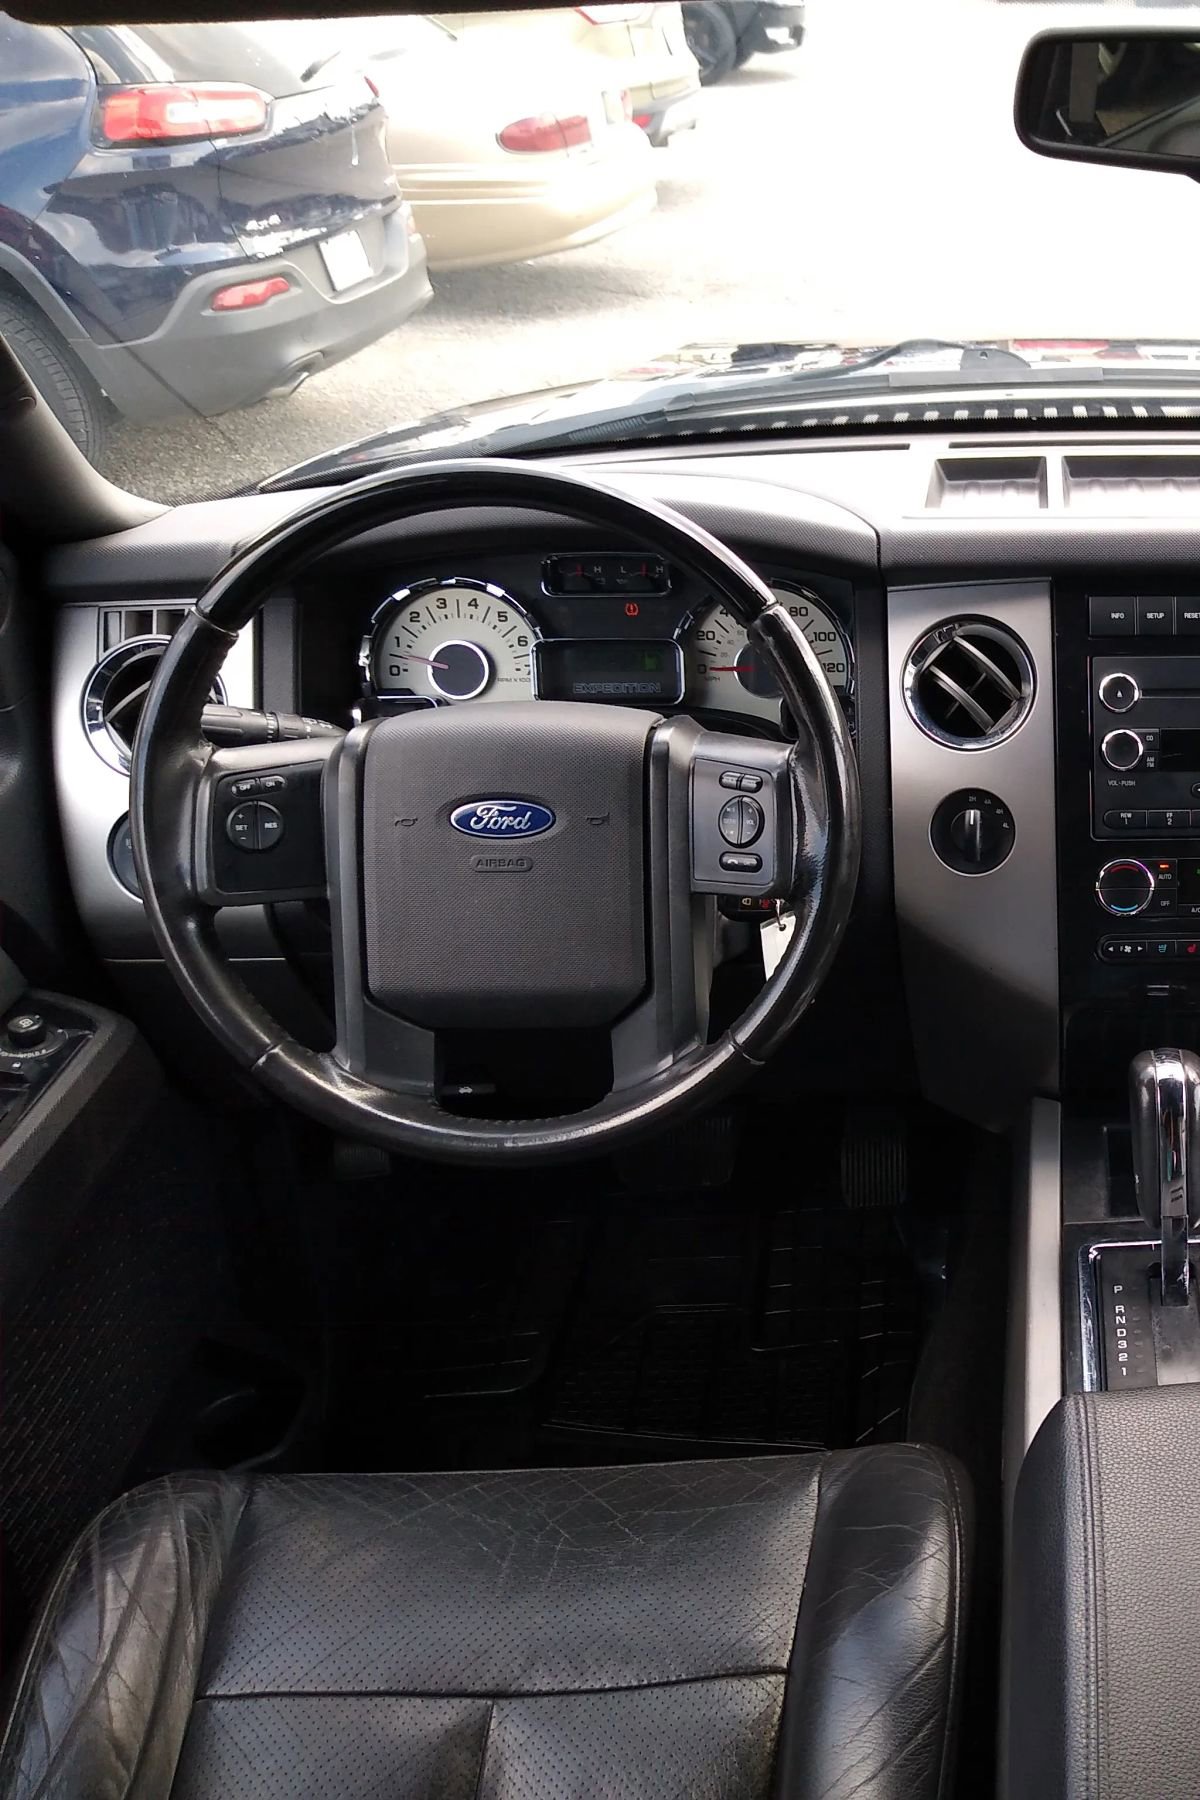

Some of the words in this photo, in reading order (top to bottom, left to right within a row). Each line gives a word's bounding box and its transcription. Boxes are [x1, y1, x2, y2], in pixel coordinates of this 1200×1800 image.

[436, 598, 447, 609] 3
[468, 598, 479, 609] 4
[409, 611, 420, 623] 2
[498, 611, 508, 622] 5
[789, 606, 809, 617] 80
[696, 630, 716, 641] 20
[813, 631, 837, 642] 100
[394, 636, 401, 647] 1
[517, 636, 528, 647] 6
[389, 665, 400, 676] 0
[697, 664, 707, 675] 0
[822, 662, 845, 673] 120
[573, 682, 662, 694] EXPEDITION
[470, 805, 532, 830] Ford
[476, 858, 526, 868] AIRBAG
[1113, 1285, 1123, 1293] P
[1115, 1305, 1125, 1313] R
[1115, 1316, 1126, 1324] N
[1116, 1329, 1127, 1337] D
[1117, 1340, 1128, 1349] 3
[1118, 1353, 1129, 1361] 2
[1121, 1367, 1127, 1376] 1
